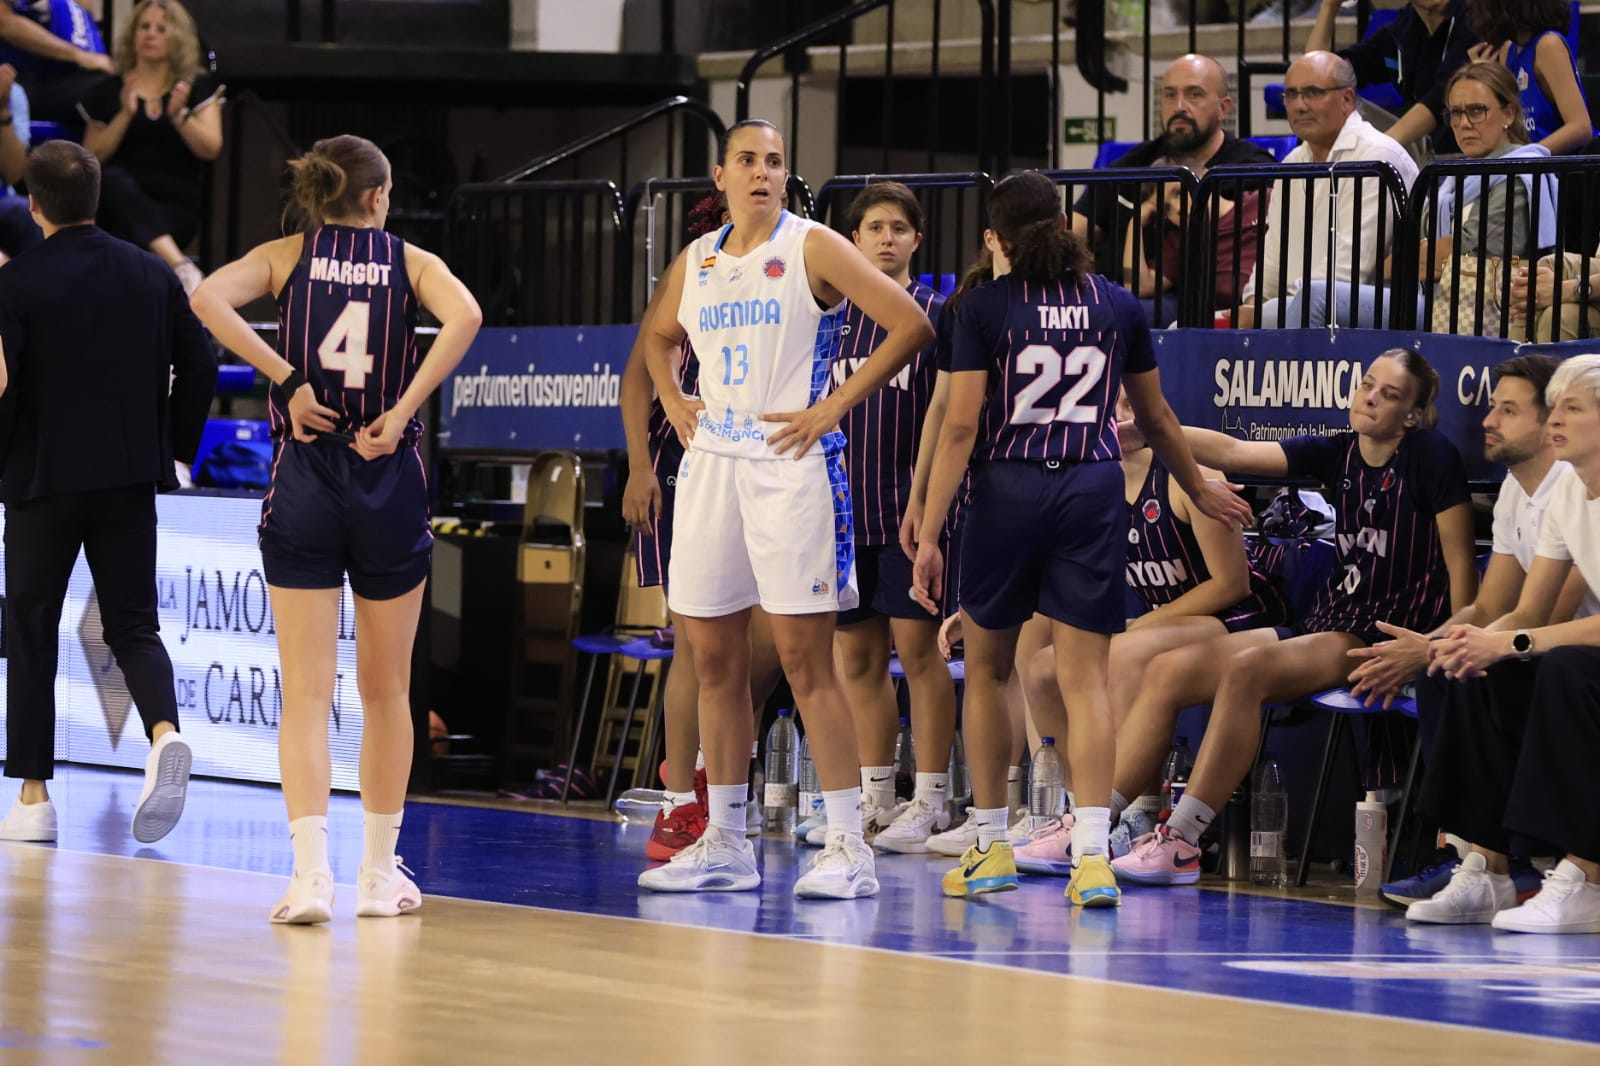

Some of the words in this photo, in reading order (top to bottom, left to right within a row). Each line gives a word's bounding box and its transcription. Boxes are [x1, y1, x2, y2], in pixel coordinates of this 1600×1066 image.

[309, 256, 392, 287] MARGOT
[699, 297, 781, 333] AVENIDA
[1037, 305, 1090, 330] TAKYI
[317, 300, 375, 390] 4
[721, 343, 750, 386] 13
[1009, 344, 1107, 425] 22
[1250, 422, 1295, 441] Patrimonio
[159, 577, 178, 610] LA
[177, 678, 198, 708] DE
